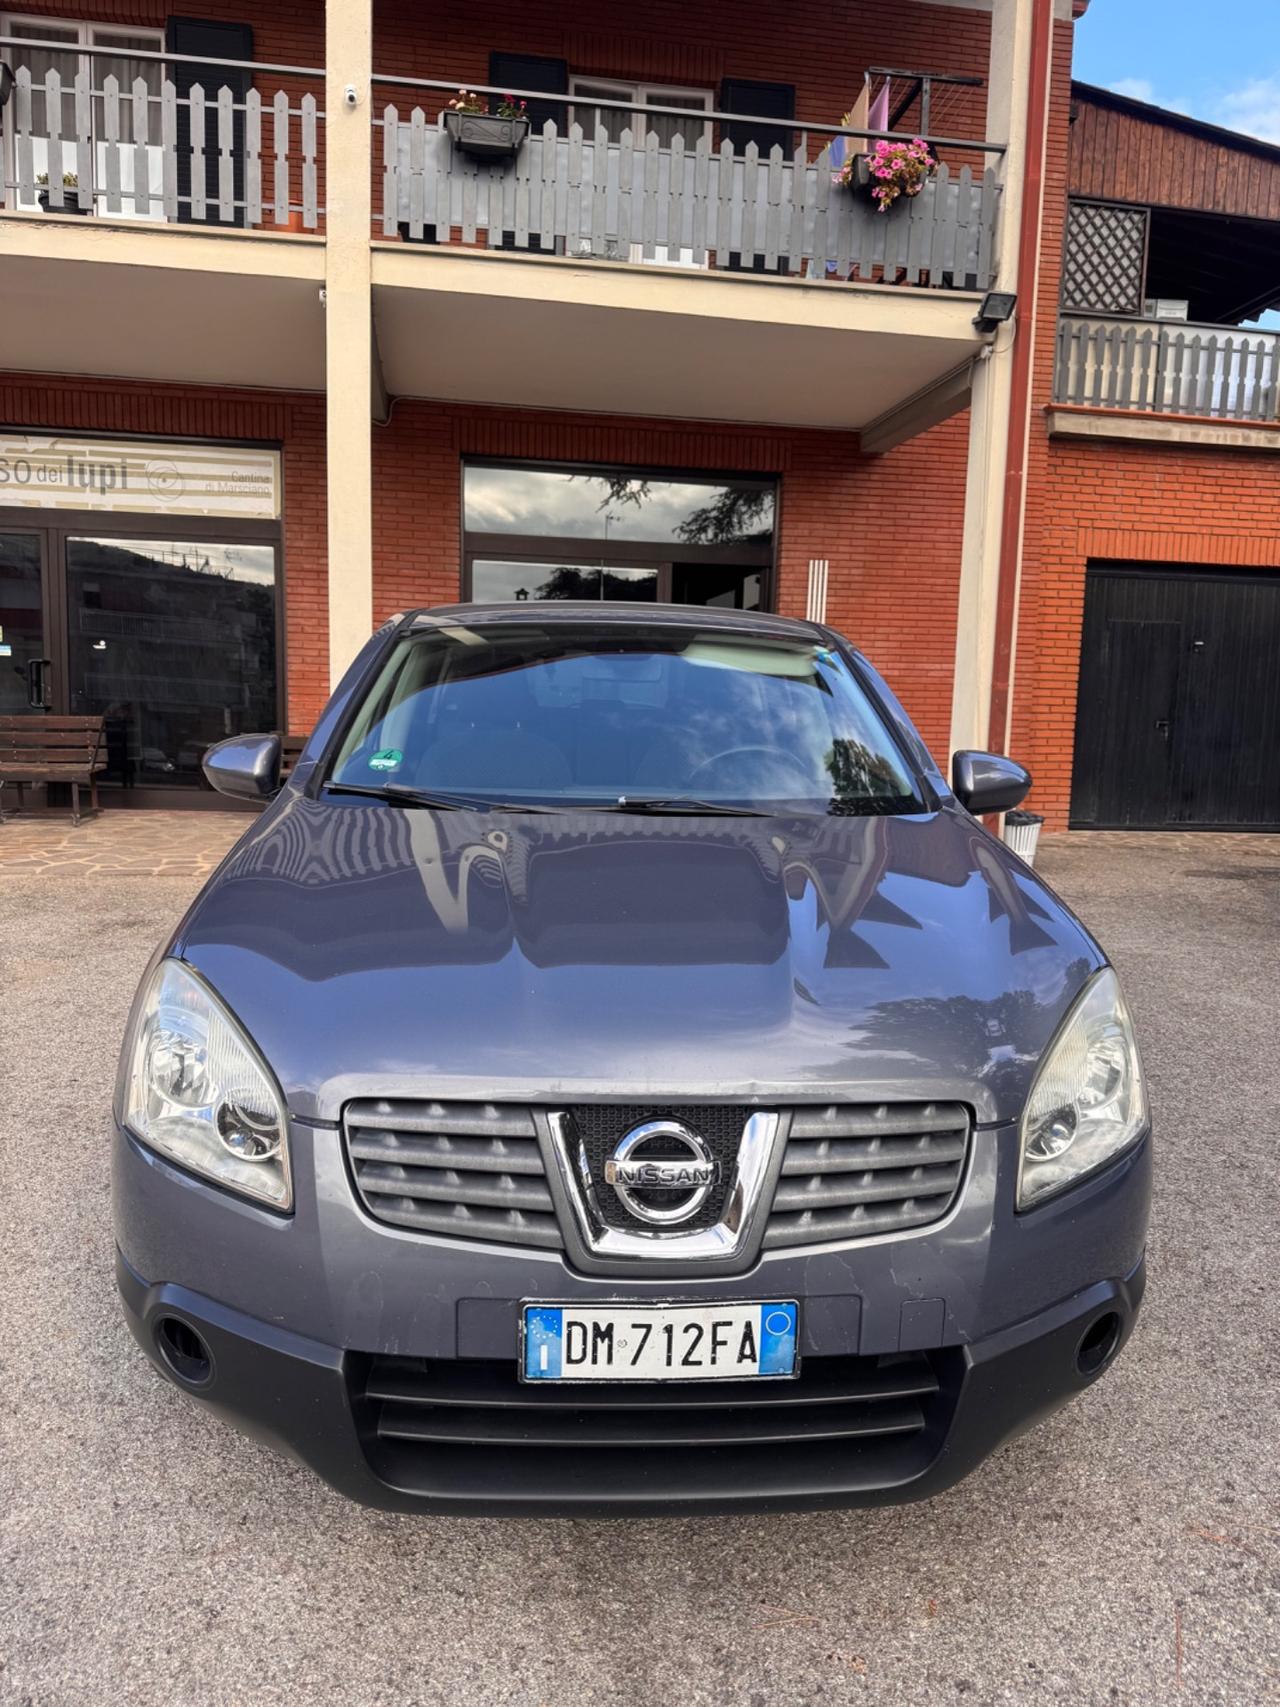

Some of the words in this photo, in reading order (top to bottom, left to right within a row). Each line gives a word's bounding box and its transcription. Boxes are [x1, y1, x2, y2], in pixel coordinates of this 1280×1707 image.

[37, 464, 63, 483] dei
[67, 455, 127, 495] lupi
[617, 1167, 711, 1182] NISSAN
